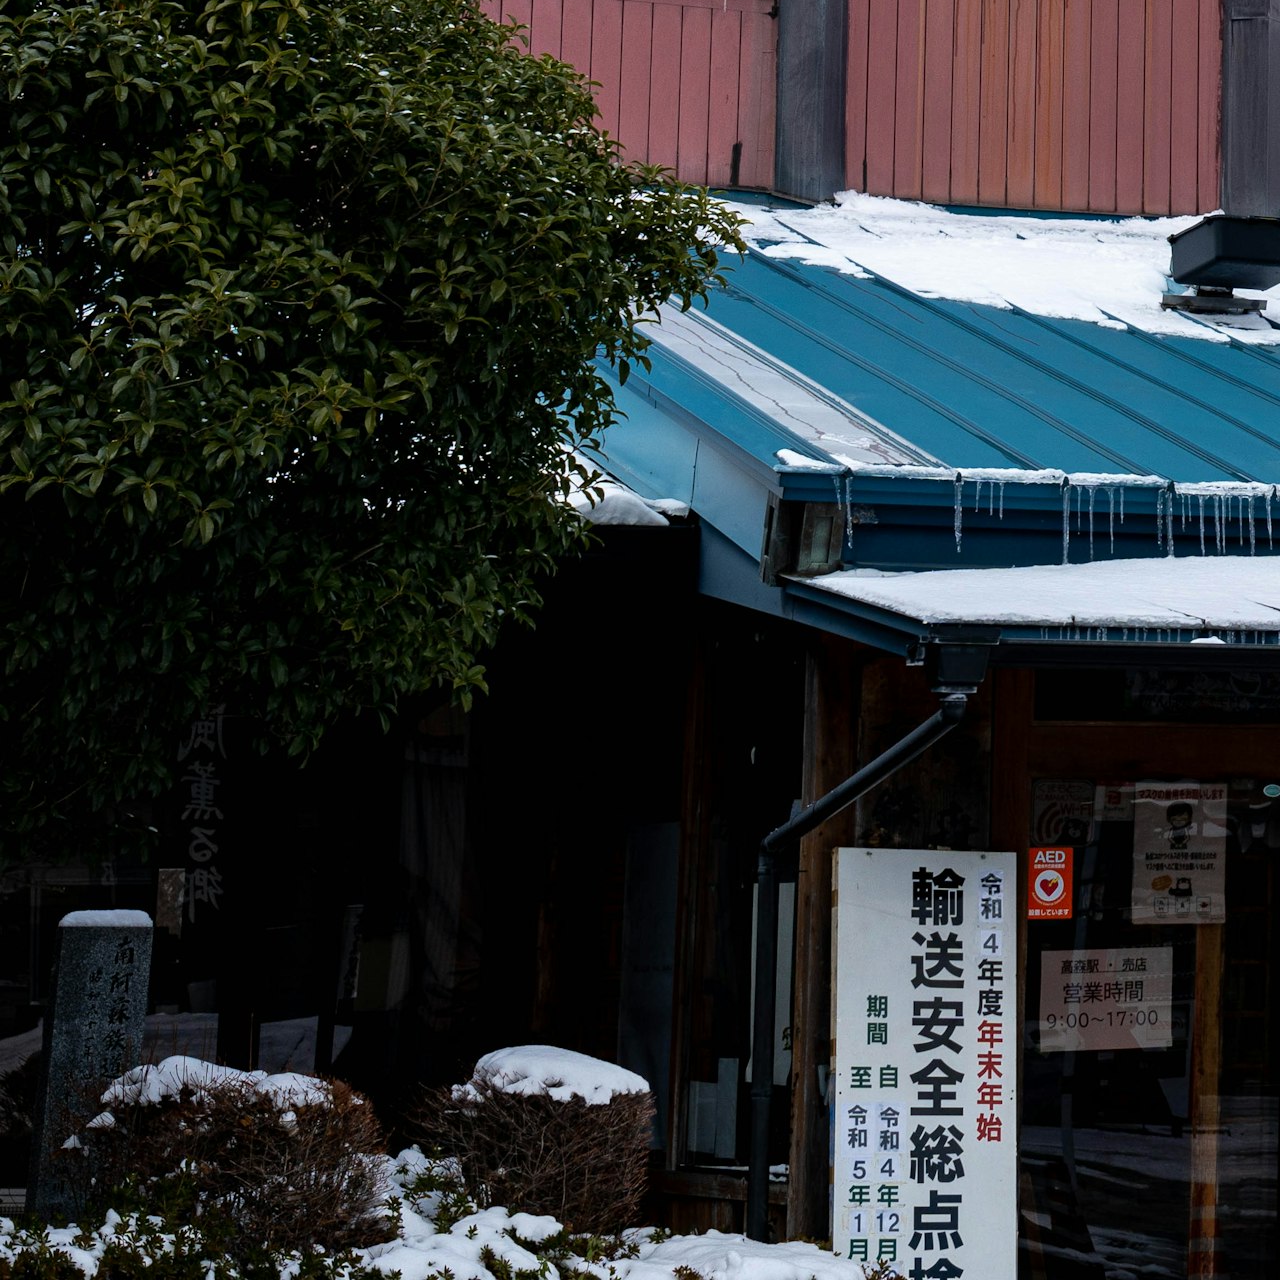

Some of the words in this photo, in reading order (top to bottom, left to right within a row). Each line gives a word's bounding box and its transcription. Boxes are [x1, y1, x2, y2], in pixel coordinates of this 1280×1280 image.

[1034, 850, 1066, 863] AED
[1061, 959, 1100, 974] 高森駅
[1122, 957, 1147, 972] 売店
[1063, 981, 1144, 1004] 営業時間
[977, 873, 1003, 1142] 令和4年度年末年始
[867, 995, 888, 1045] 期間
